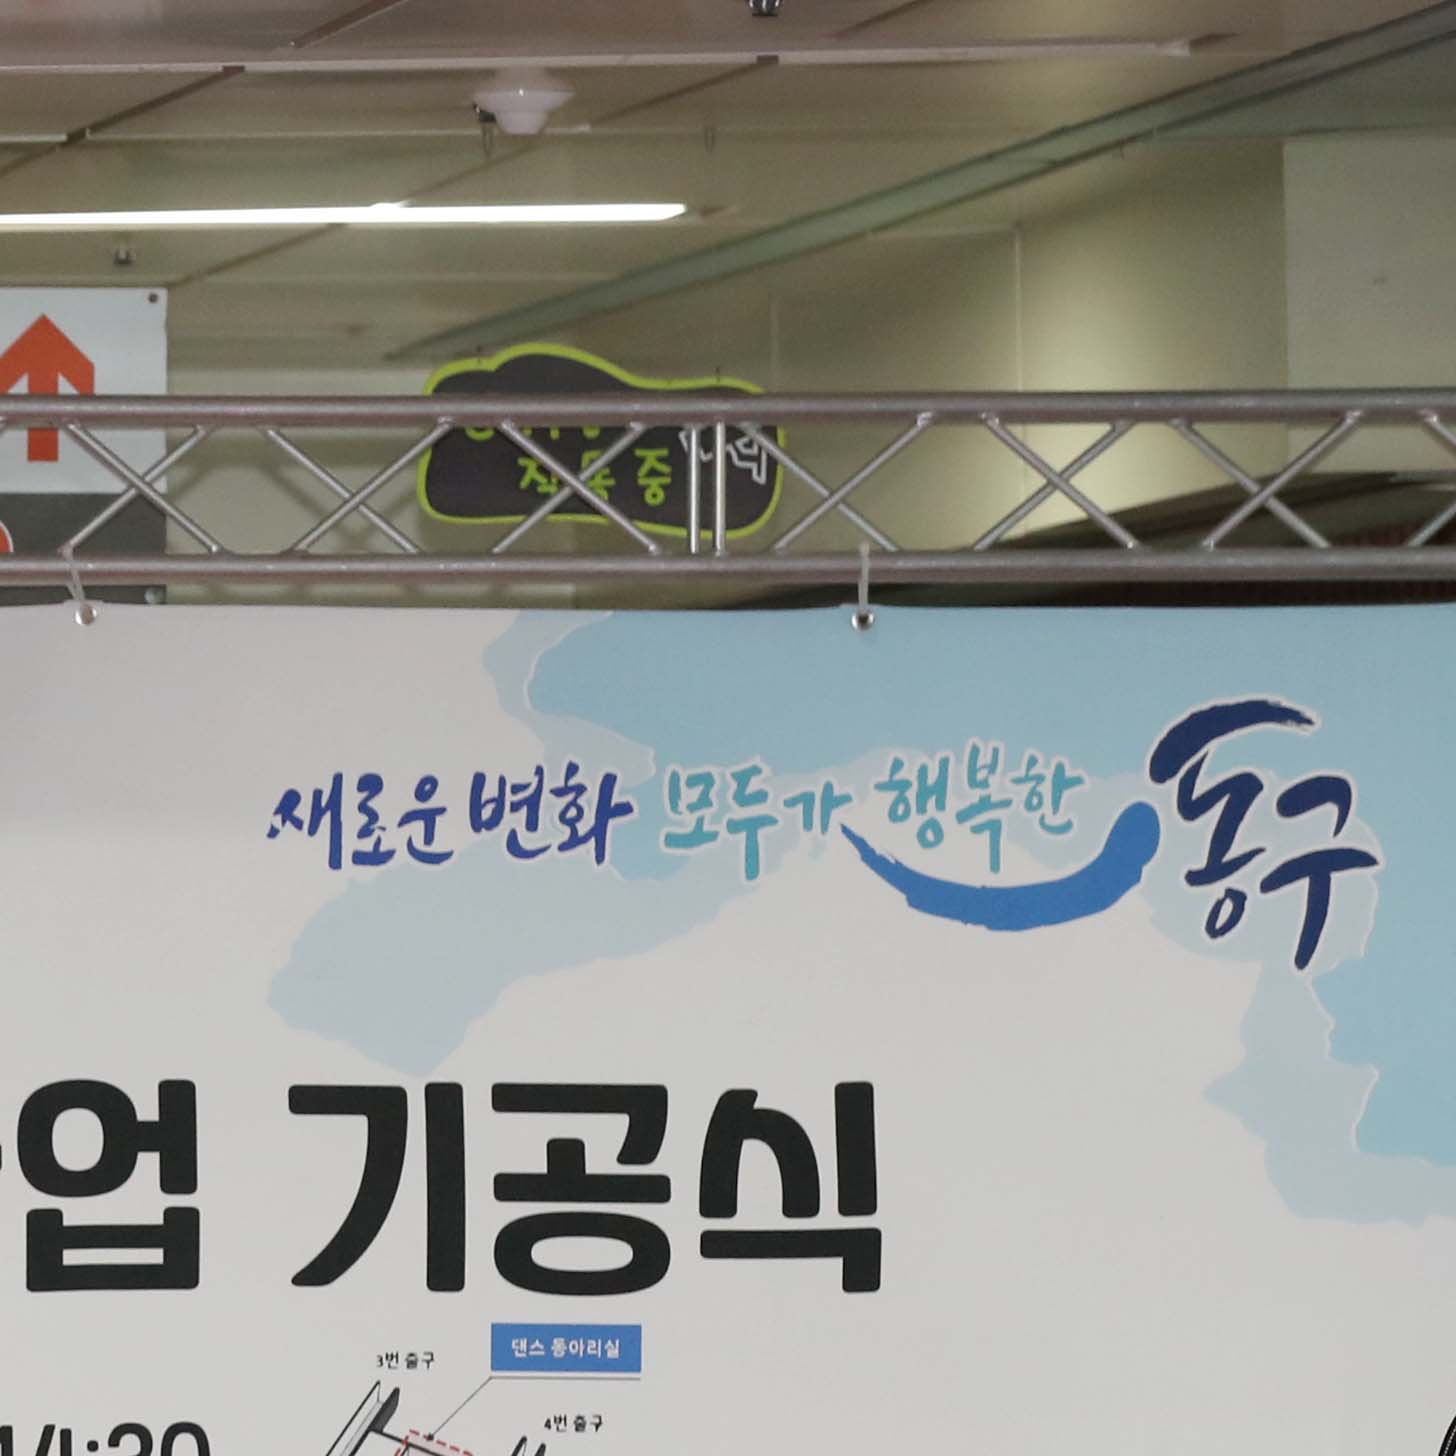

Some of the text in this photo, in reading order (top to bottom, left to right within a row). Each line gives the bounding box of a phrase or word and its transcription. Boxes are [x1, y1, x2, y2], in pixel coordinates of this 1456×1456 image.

[266, 698, 1380, 971] 새로운 변화 모두가 행복한 동구
[288, 1080, 883, 1298] 기공식
[510, 1337, 621, 1360] 댄스 동아리실
[377, 1351, 437, 1371] 3번 출구
[543, 1414, 605, 1434] 4번 출구
